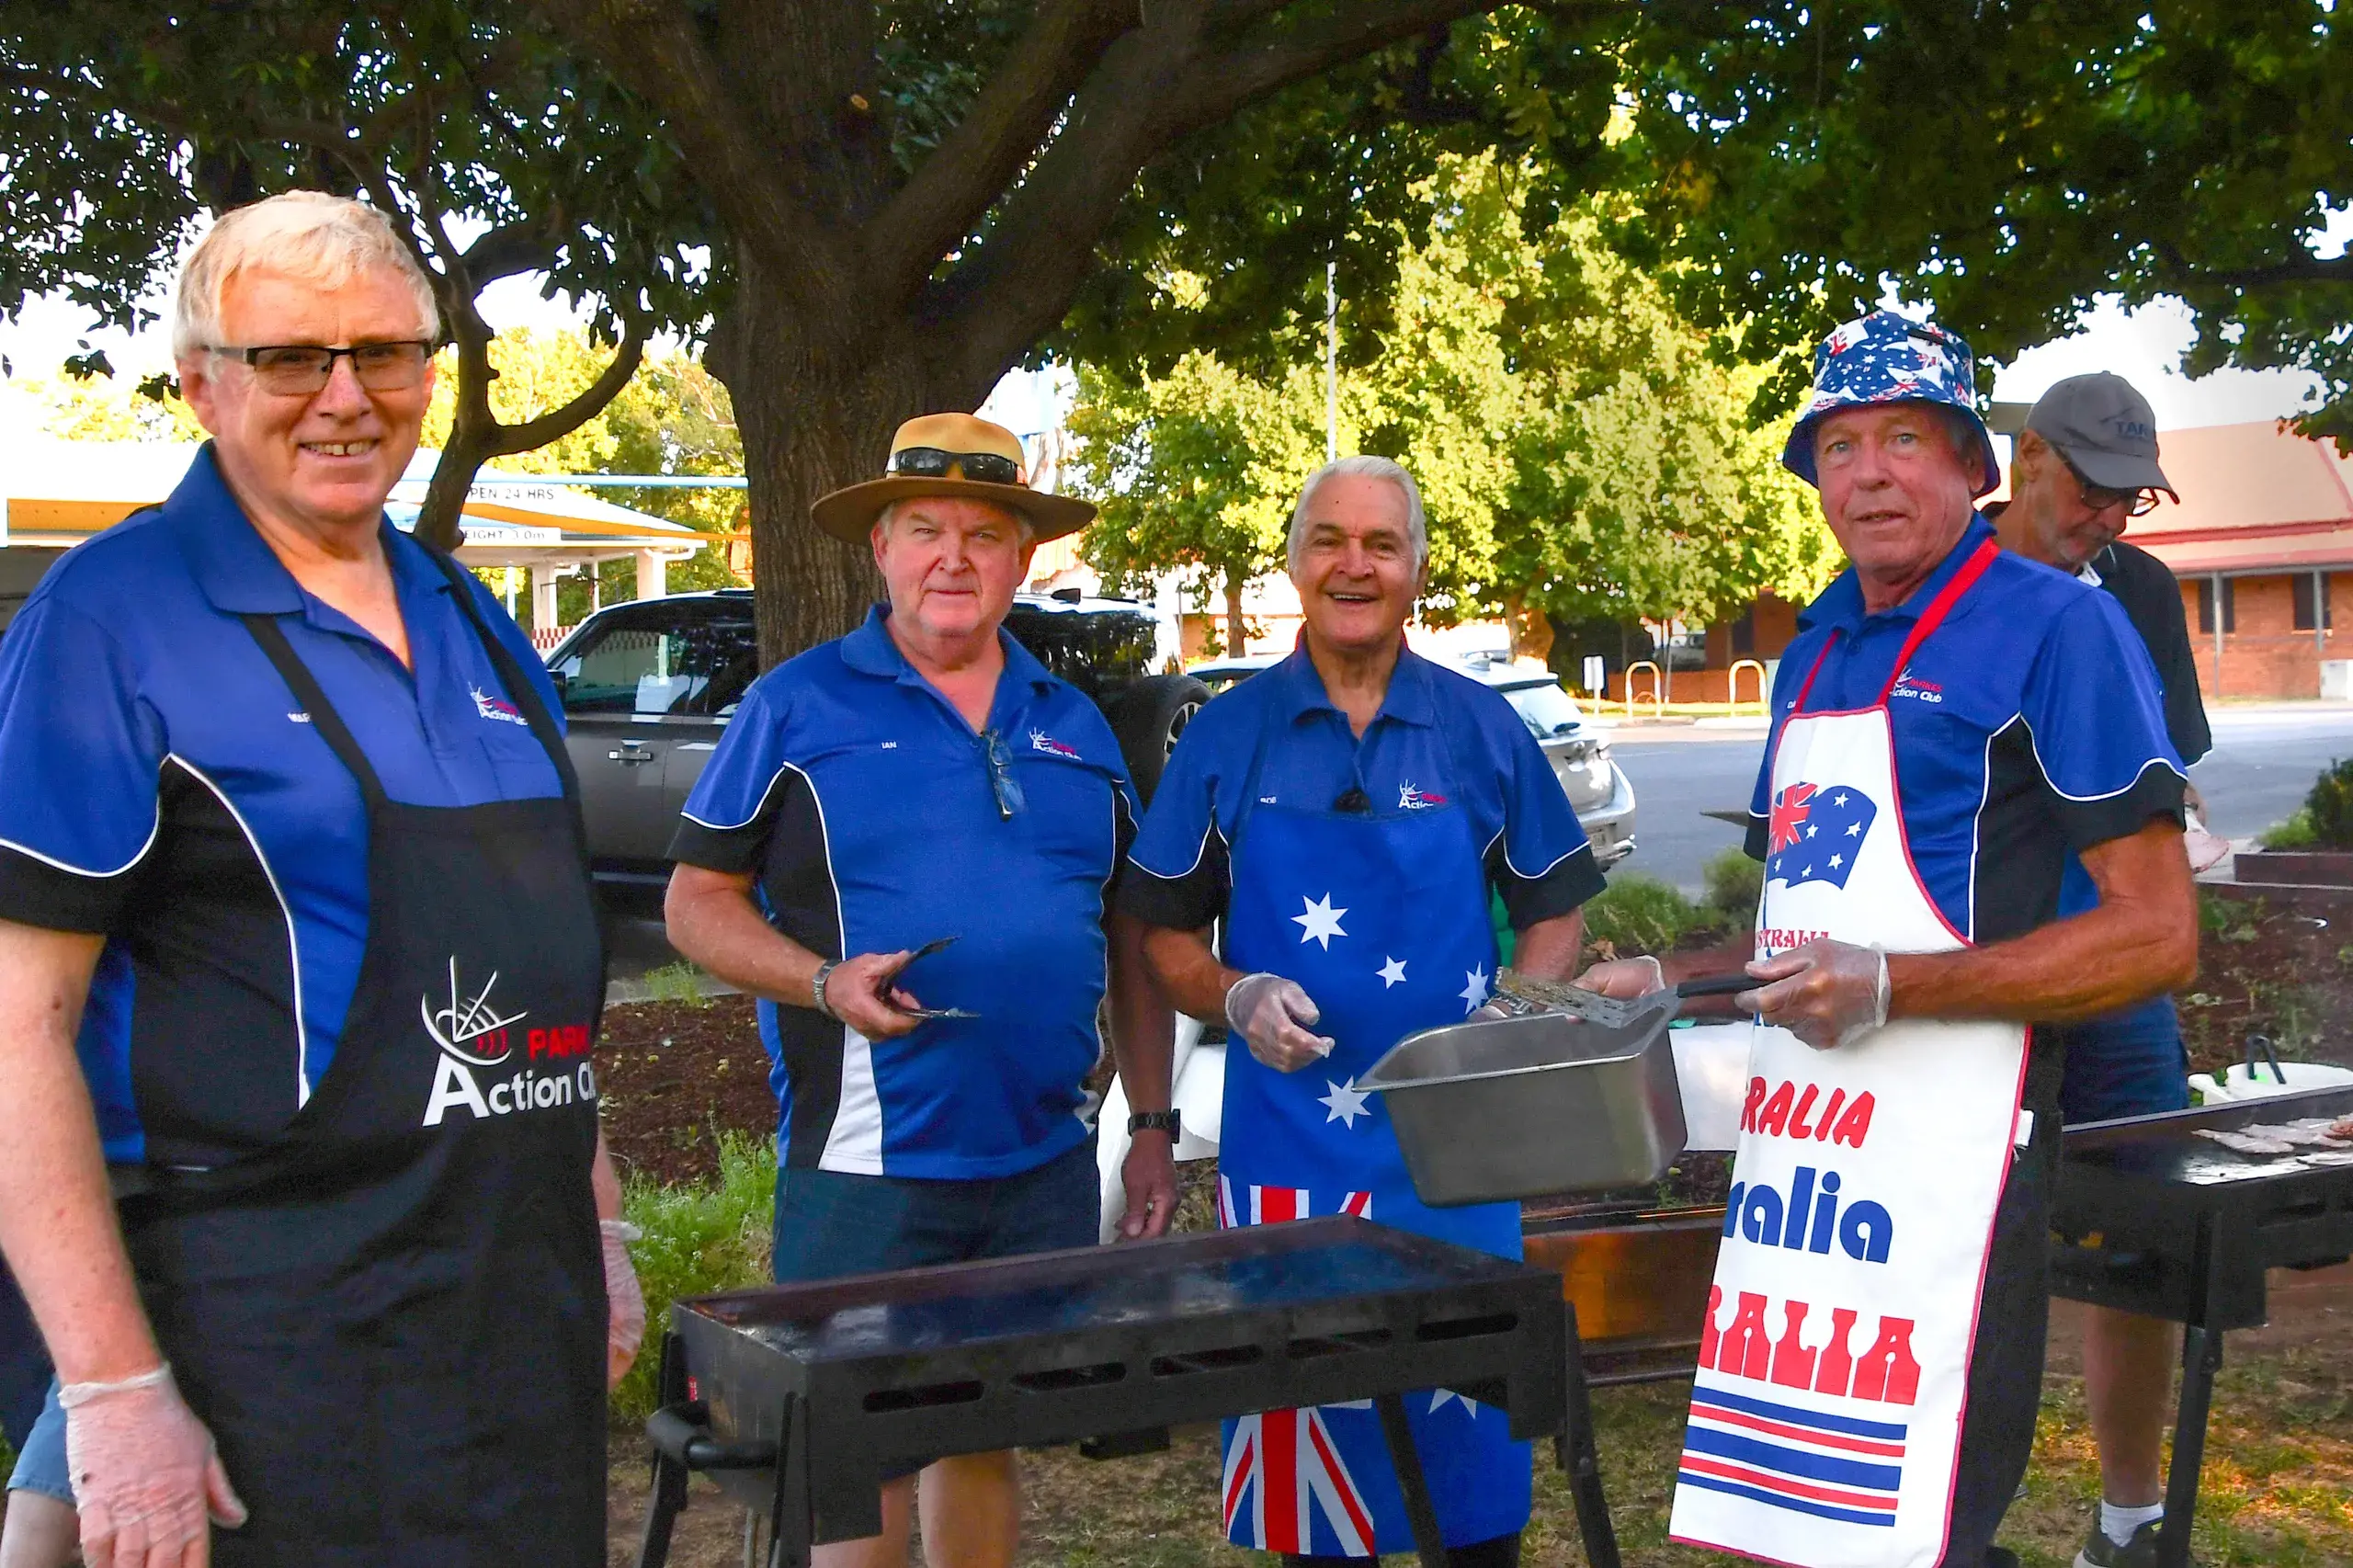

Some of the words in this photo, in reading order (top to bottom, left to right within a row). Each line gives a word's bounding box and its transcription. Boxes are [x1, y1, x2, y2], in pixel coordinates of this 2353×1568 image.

[470, 486, 497, 499] PEN
[505, 488, 520, 499] 24
[528, 489, 554, 500] HRS
[464, 529, 504, 540] EIGHT
[1919, 690, 1943, 704] Club
[881, 741, 897, 749] IAN
[527, 1024, 590, 1062] PARK
[422, 1052, 573, 1127] Action
[576, 1061, 597, 1101] Cl
[1740, 1075, 1876, 1149] RALIA
[1722, 1165, 1893, 1264] ralia
[1699, 1283, 1922, 1406] RALIA
